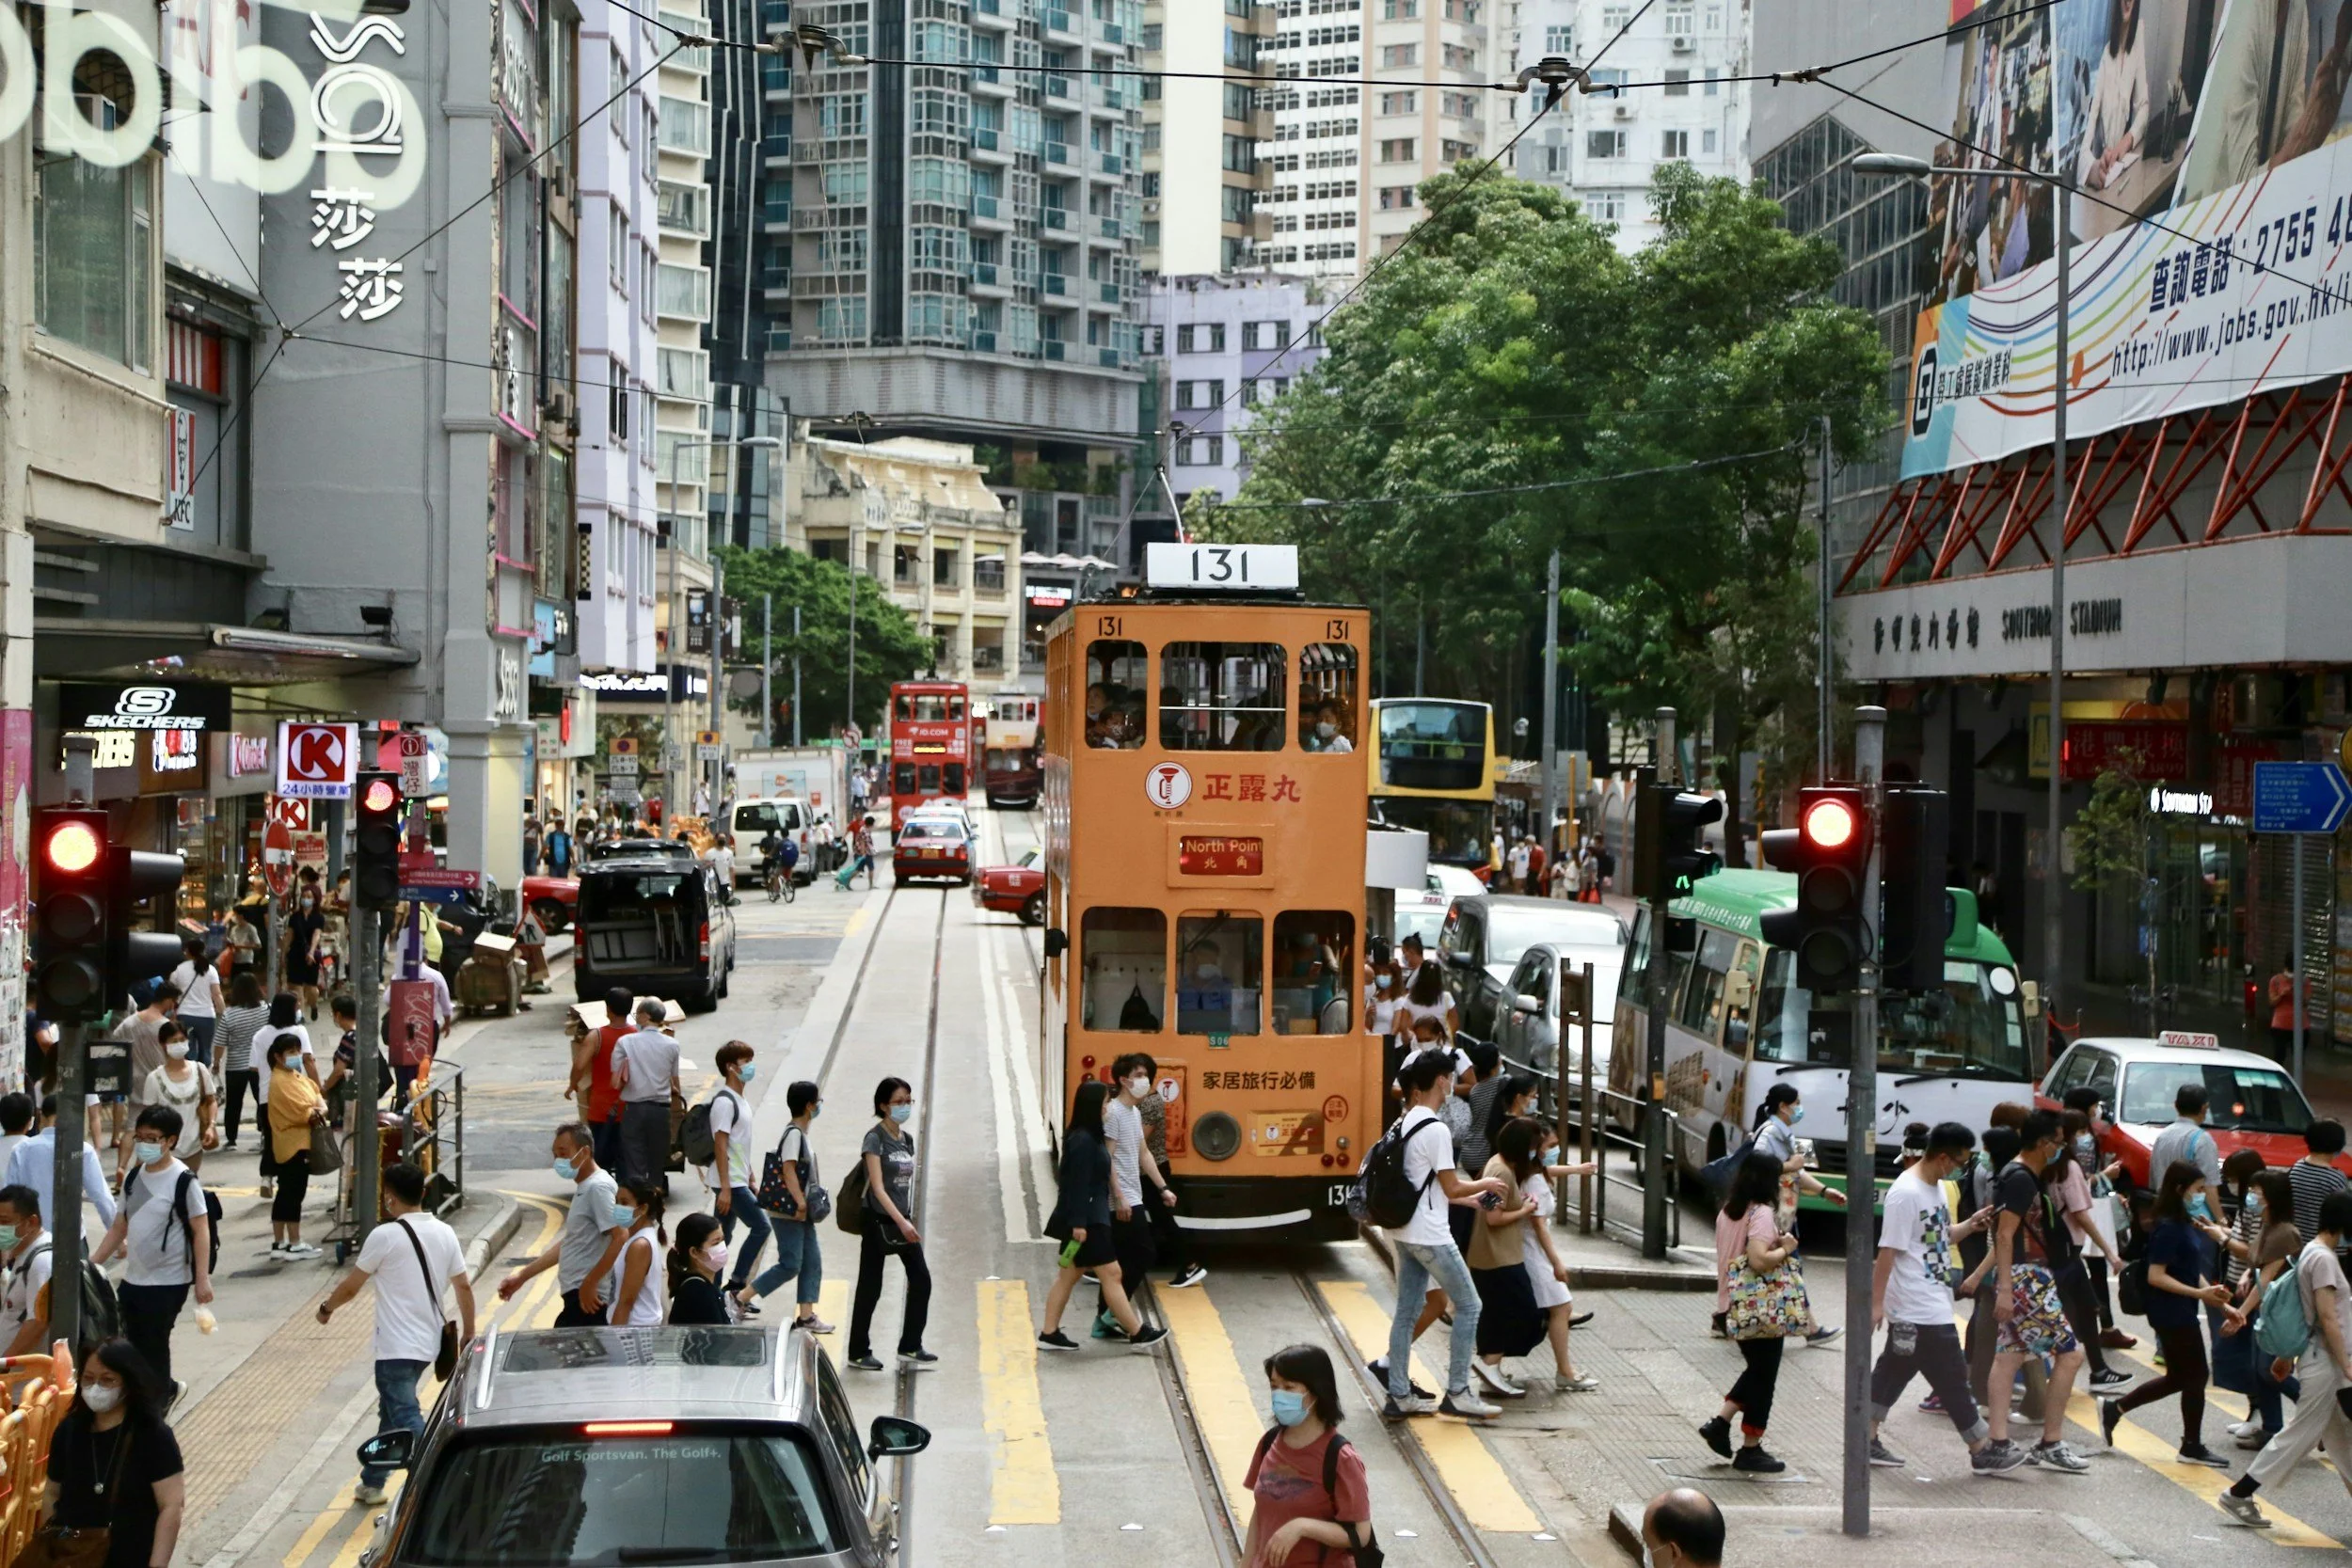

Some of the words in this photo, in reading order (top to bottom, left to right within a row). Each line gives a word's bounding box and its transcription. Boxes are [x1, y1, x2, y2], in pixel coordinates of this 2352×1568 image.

[2253, 205, 2317, 276] 2755
[310, 186, 403, 321] 莎莎
[174, 498, 191, 523] KFC
[1191, 548, 1248, 582] 131
[1098, 616, 1122, 637] 131
[2002, 604, 2053, 641] SOUTHOR
[2070, 598, 2122, 637] STADIUM
[1327, 620, 1349, 640] 131
[85, 714, 206, 729] SKECHERS
[403, 760, 420, 793] 灣仔
[282, 784, 350, 797] 24小時營業
[1202, 774, 1300, 802] 正露丸
[1186, 840, 1225, 853] North
[1204, 856, 1248, 870] 北角
[2166, 1033, 2215, 1047] TAXI
[1202, 1070, 1316, 1090] 家居旅行必備
[541, 1449, 570, 1463] Golf
[574, 1449, 648, 1464] Sportsvan.
[652, 1448, 677, 1459] The
